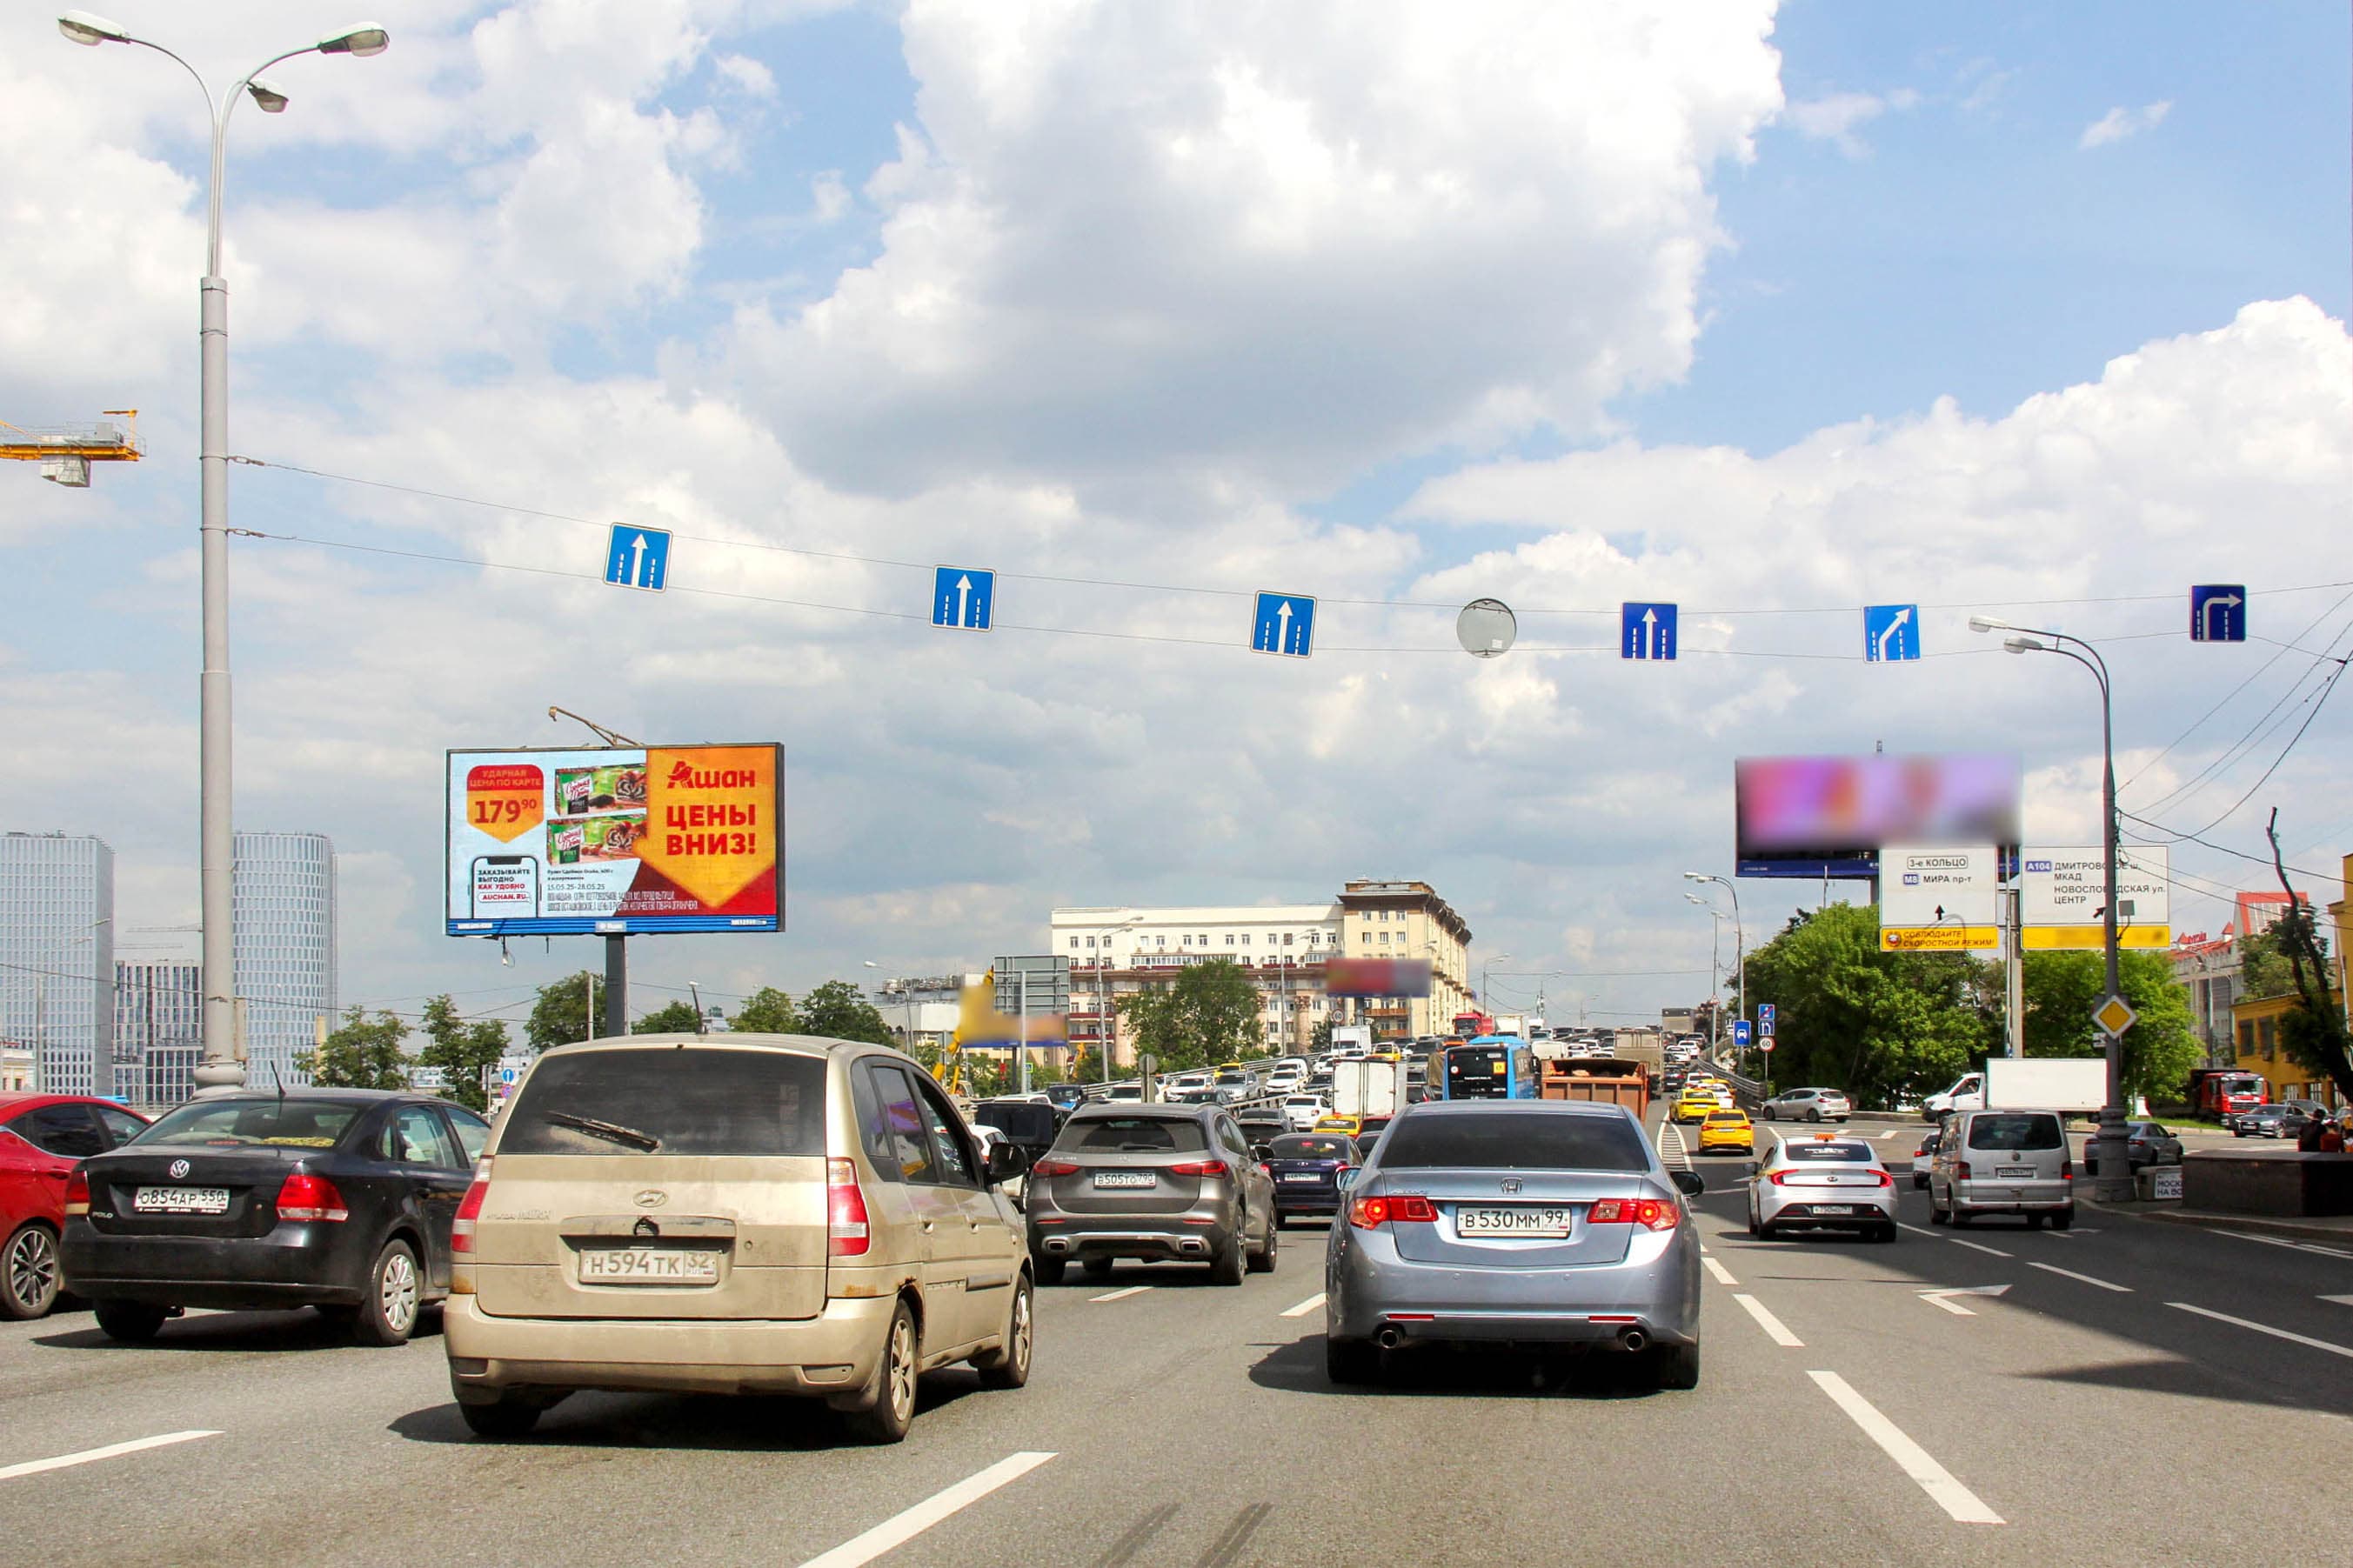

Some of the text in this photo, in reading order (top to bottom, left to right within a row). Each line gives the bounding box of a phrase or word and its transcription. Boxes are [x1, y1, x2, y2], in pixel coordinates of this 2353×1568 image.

[481, 770, 527, 778] УДАРНАЯ
[666, 760, 756, 789] Ашан
[470, 778, 496, 787] ЦЕНА
[511, 777, 543, 786] КАРТЕ
[474, 798, 538, 824] 179 90
[666, 804, 756, 831] ЦЕНЫ
[666, 832, 756, 856] ВНИЗ!
[1909, 858, 1966, 867] 3-е КОЛЬЦО
[2054, 862, 2130, 871] ДМИТРОВСОЕ
[1545, 1210, 1564, 1224] 99
[686, 1251, 709, 1268] 32
